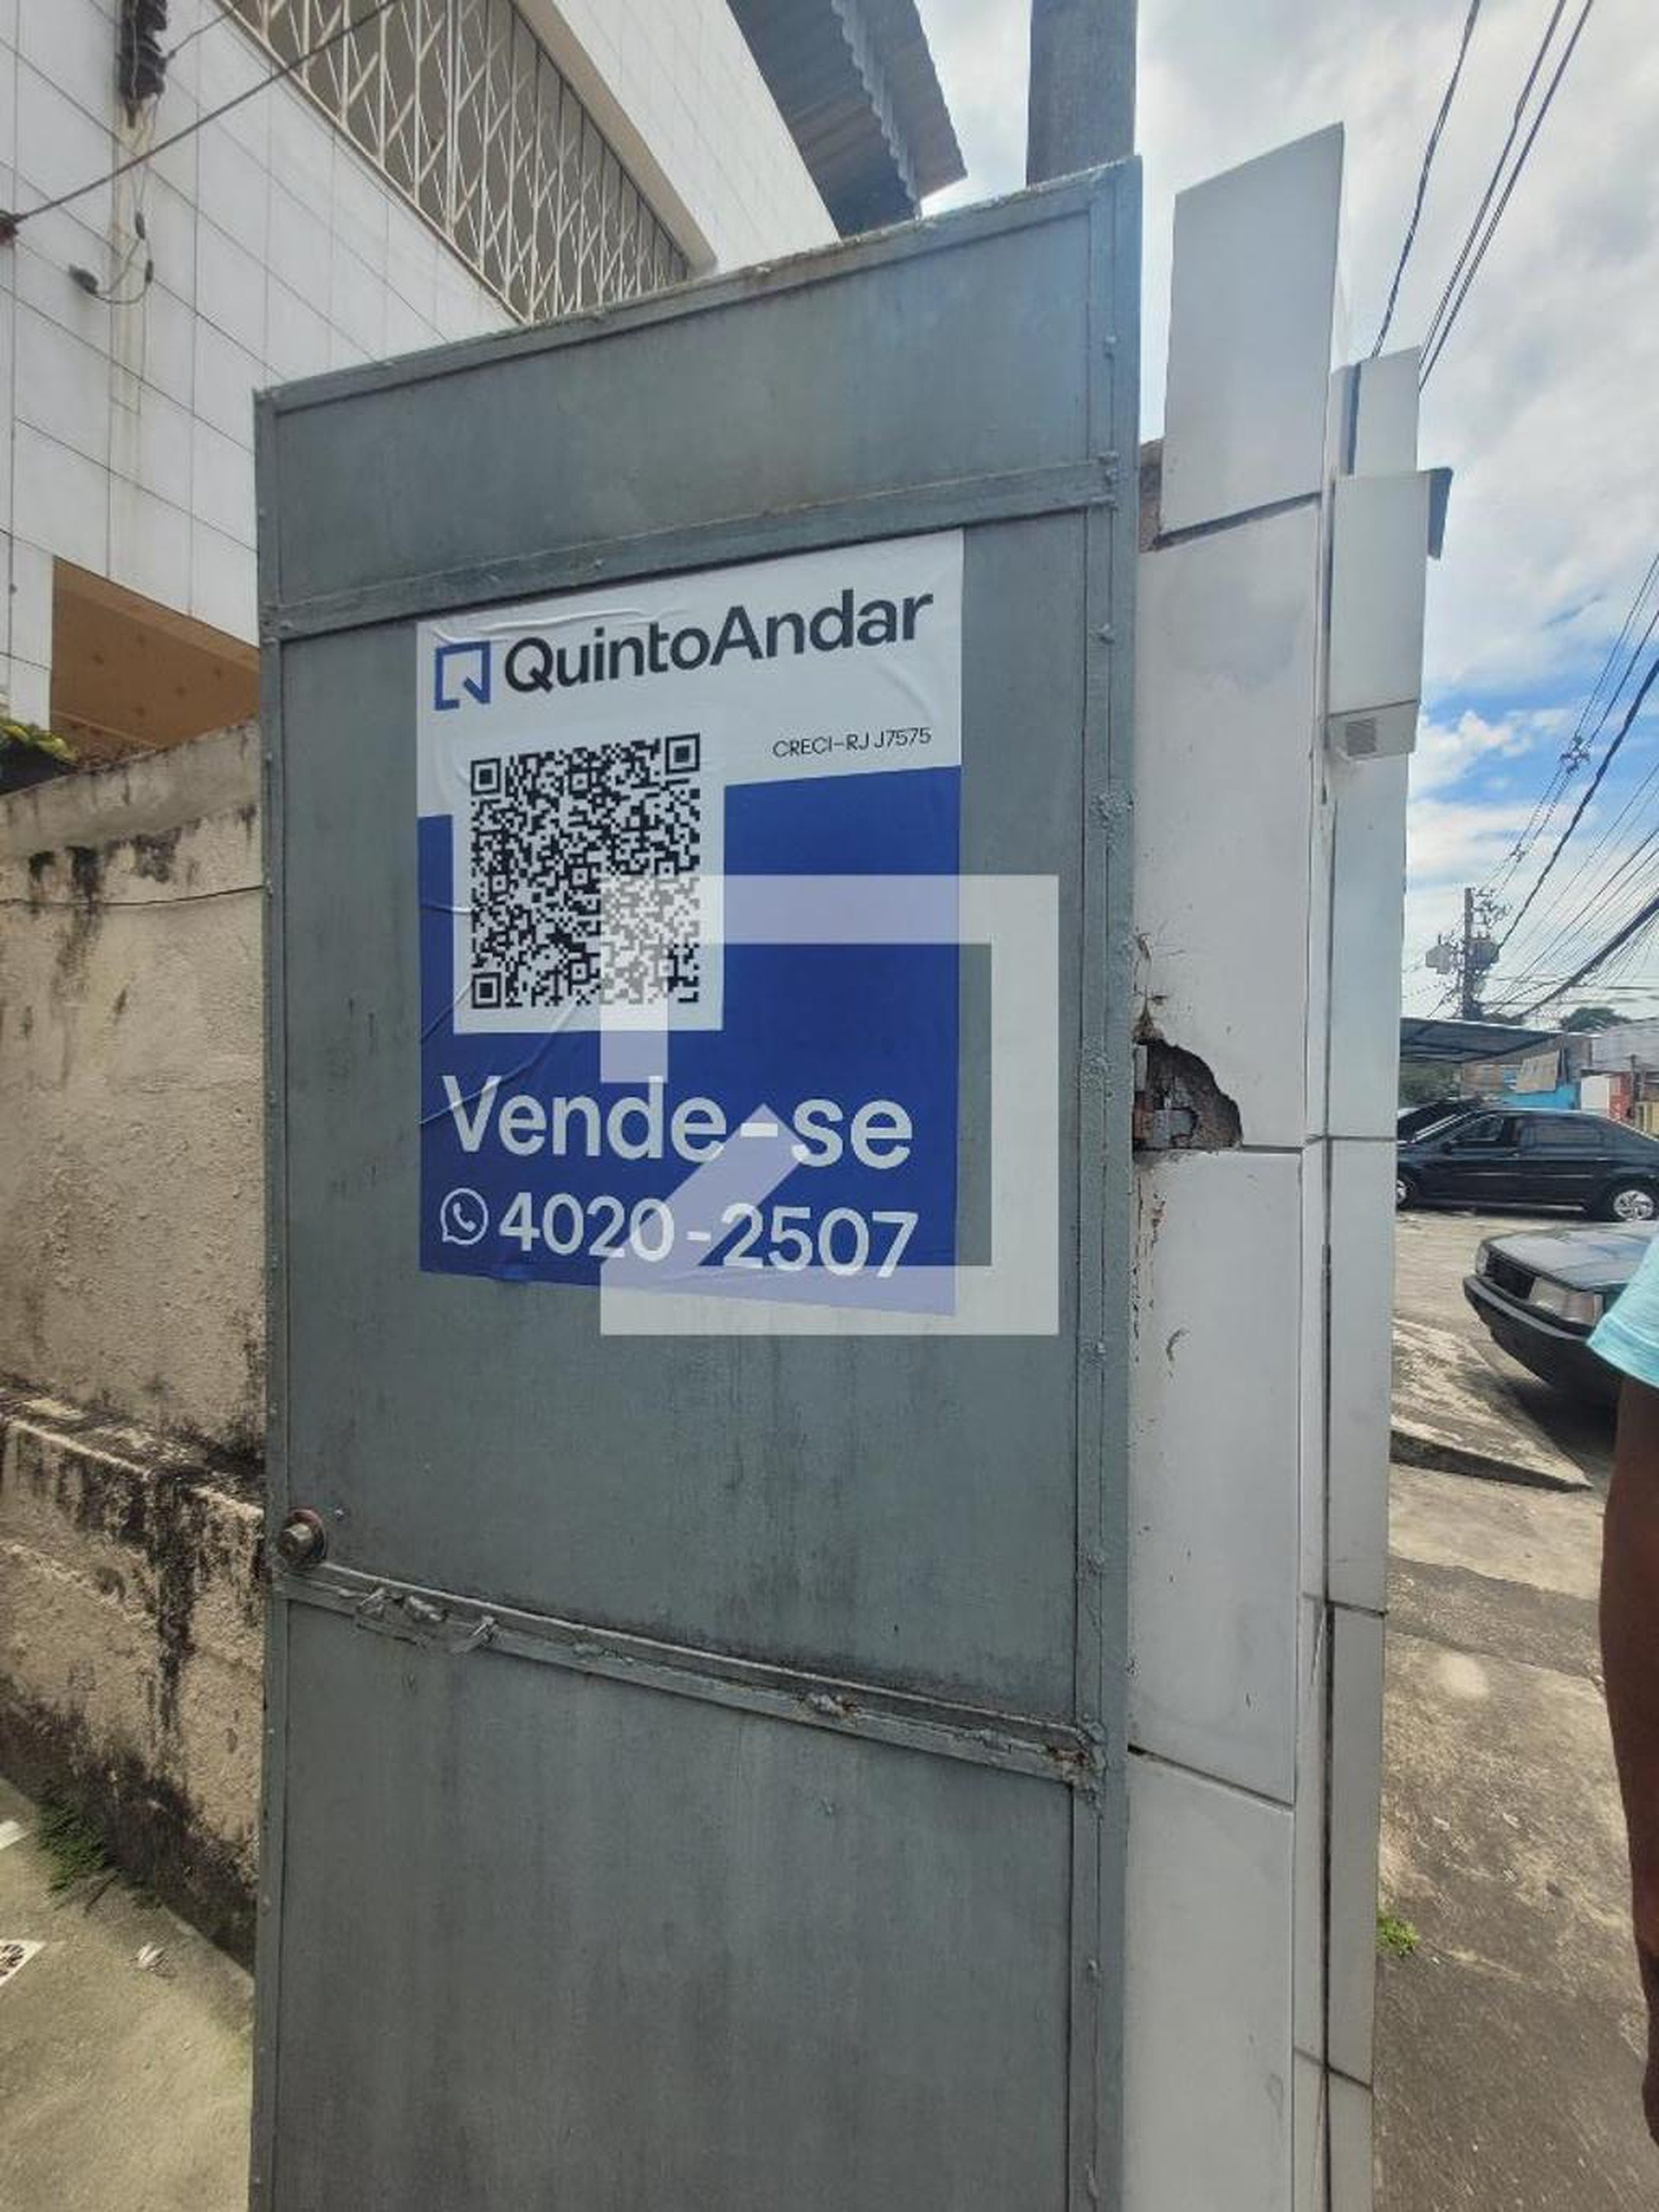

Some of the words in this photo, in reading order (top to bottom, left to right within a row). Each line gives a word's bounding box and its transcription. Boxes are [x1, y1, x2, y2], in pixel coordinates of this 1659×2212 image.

[504, 589, 934, 693] QuintoAndar
[772, 732, 869, 757] CRECI-RJ
[874, 727, 932, 748] J7575
[442, 1075, 914, 1169] Vende-se
[499, 1191, 919, 1278] 4020-2507
